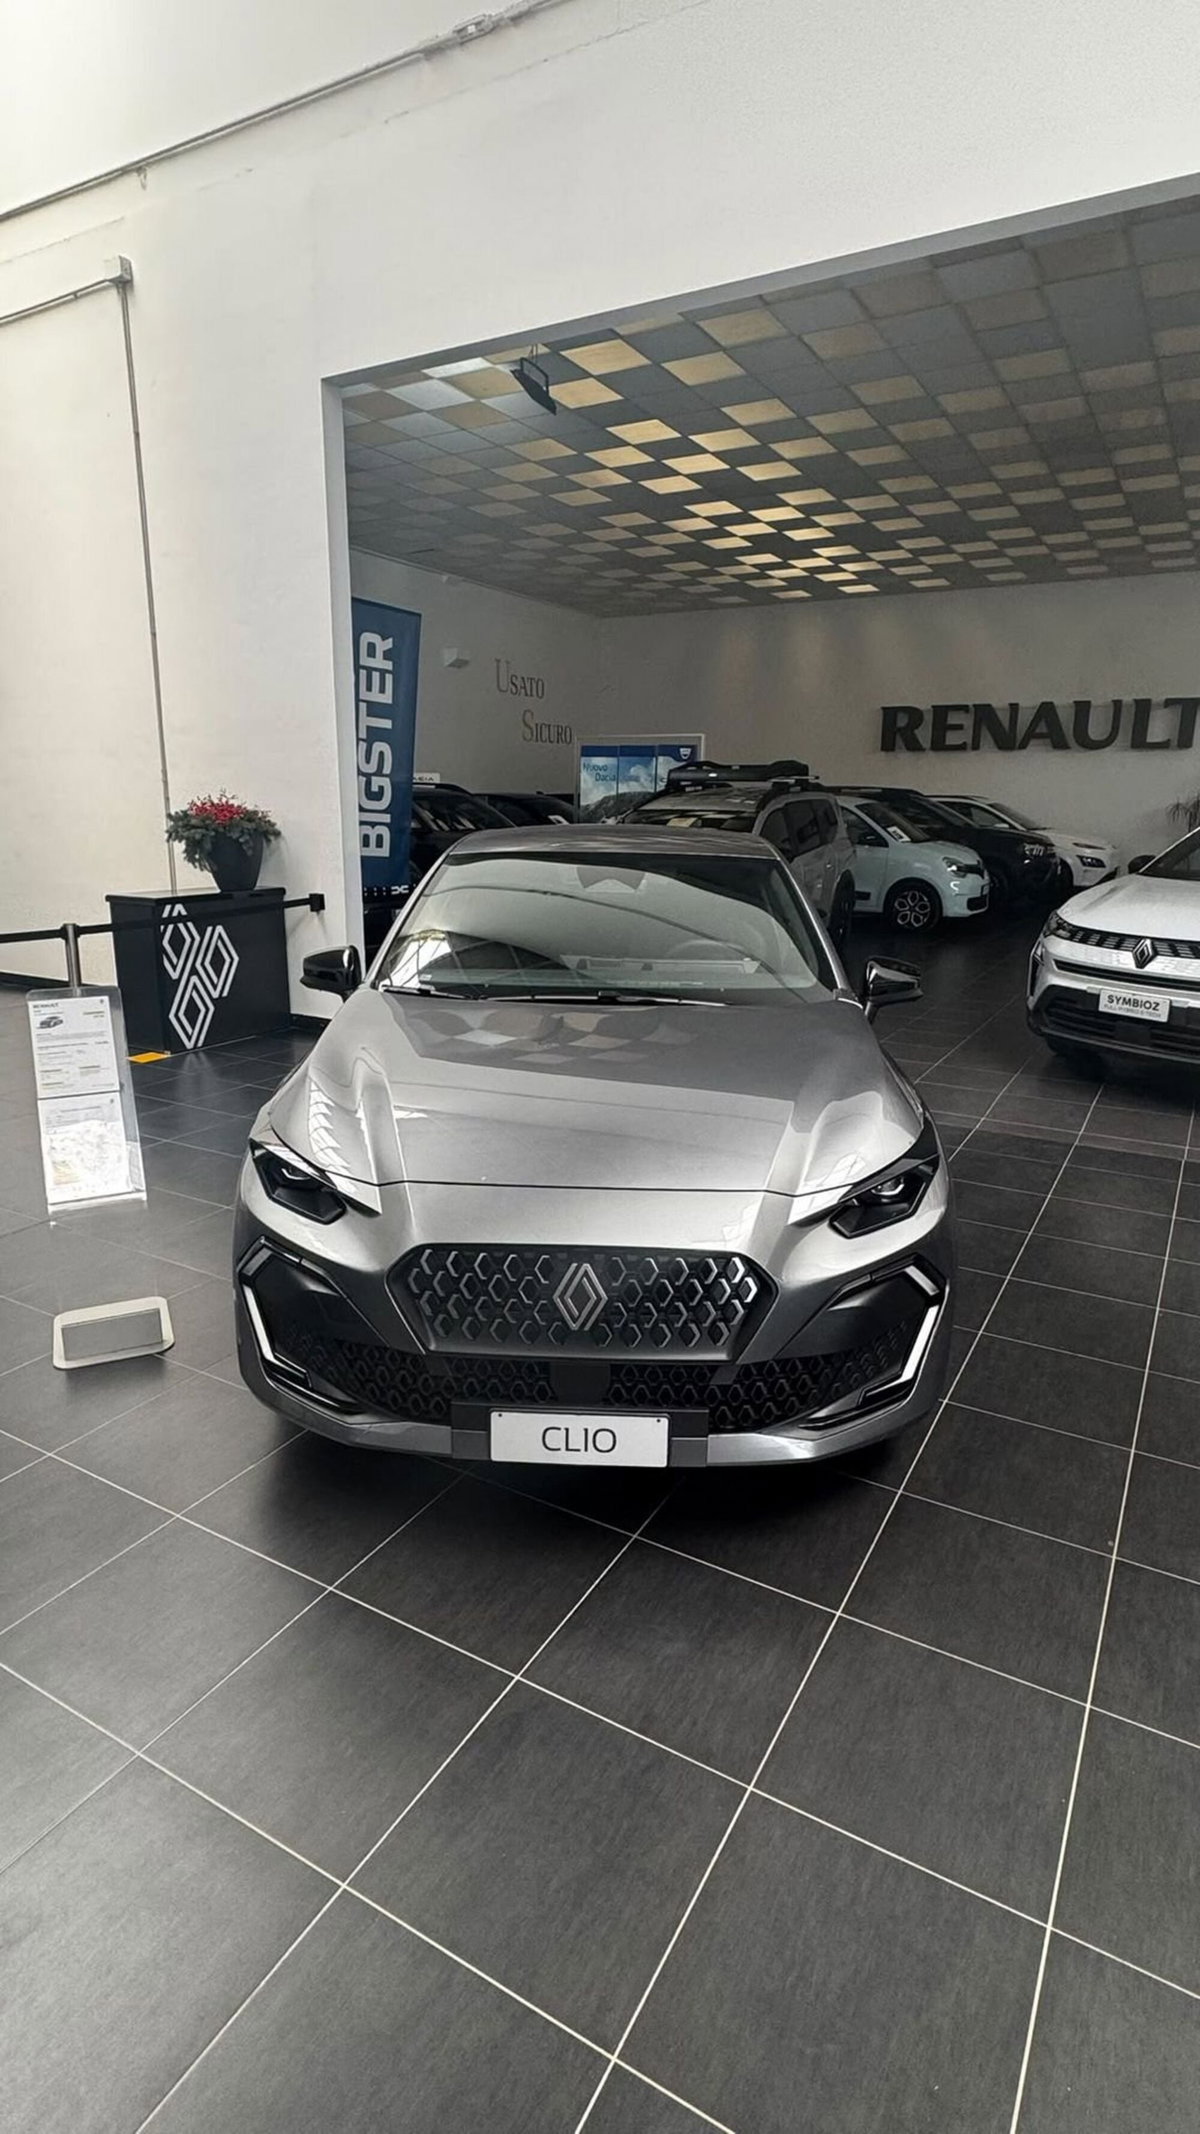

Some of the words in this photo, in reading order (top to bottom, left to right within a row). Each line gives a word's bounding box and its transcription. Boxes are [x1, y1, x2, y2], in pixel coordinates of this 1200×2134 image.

[358, 631, 393, 858] BIGSTER
[880, 697, 1200, 752] RENAULT
[1107, 994, 1160, 1011] SYMBIOZ
[541, 1426, 617, 1454] CLIO
